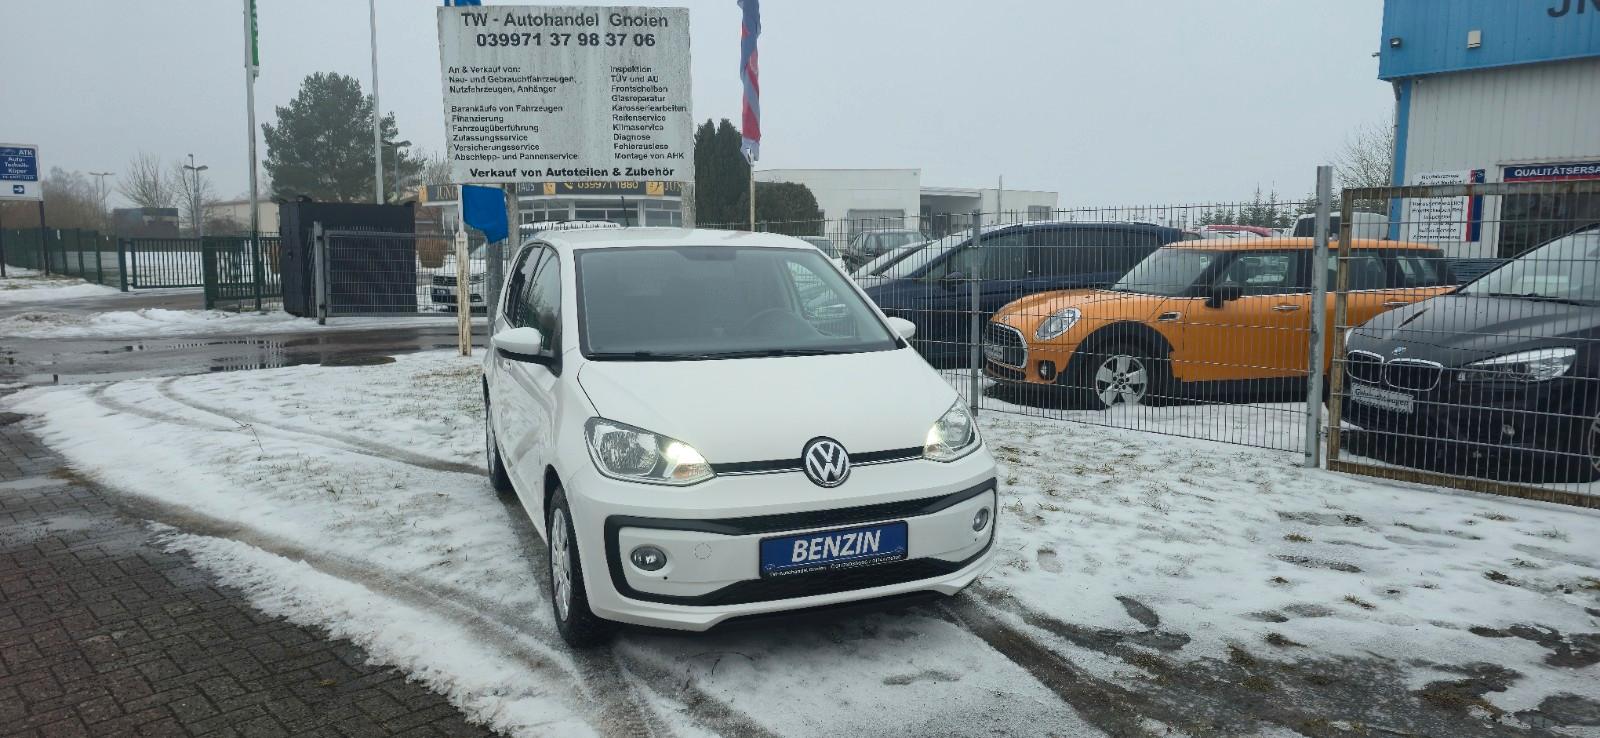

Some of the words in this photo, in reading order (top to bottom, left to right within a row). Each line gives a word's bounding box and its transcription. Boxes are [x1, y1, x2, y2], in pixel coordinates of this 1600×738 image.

[461, 12, 488, 27] TW
[503, 12, 599, 27] Autohandel
[609, 12, 669, 27] Gnoien
[476, 32, 542, 47] 039971
[550, 32, 572, 47] 37
[577, 32, 600, 47] 98
[605, 32, 628, 47] 37
[633, 33, 656, 47] 06
[448, 66, 460, 74] An
[462, 66, 468, 74] &
[470, 66, 501, 74] Verkauf
[502, 66, 521, 74] von:
[610, 65, 652, 74] Inspektion
[449, 75, 468, 83] Neu-
[470, 75, 486, 83] und
[610, 74, 627, 83] TÜV
[629, 75, 645, 83] und
[647, 75, 659, 83] AU
[449, 85, 516, 94] Nutzfahrzeugen,
[517, 85, 557, 94] Anhänger
[611, 85, 668, 93] Frontscheiben
[611, 94, 666, 103] Glasreparatur
[451, 105, 497, 113] Barankäufe
[516, 104, 563, 113] Fahrzeugen
[612, 104, 687, 112] Karosseriearbeiten
[452, 114, 504, 123] Finanzierung
[452, 124, 539, 133] Fahrzeugüberführung
[612, 123, 664, 131] Klimaservice
[453, 134, 529, 143] Zulassungsservice
[613, 133, 651, 142] Diagnose
[453, 143, 540, 152] Versicherungsservice
[454, 153, 500, 162] Abschlepp-
[519, 152, 578, 160] Pannenservice
[614, 152, 648, 161] Montage
[666, 152, 685, 160] AHK
[469, 168, 517, 178] Verkauf
[520, 169, 542, 177] von
[546, 167, 608, 177] Autoteilen
[612, 167, 621, 177] &
[625, 166, 675, 177] Zubehör
[791, 529, 882, 563] BENZIN
